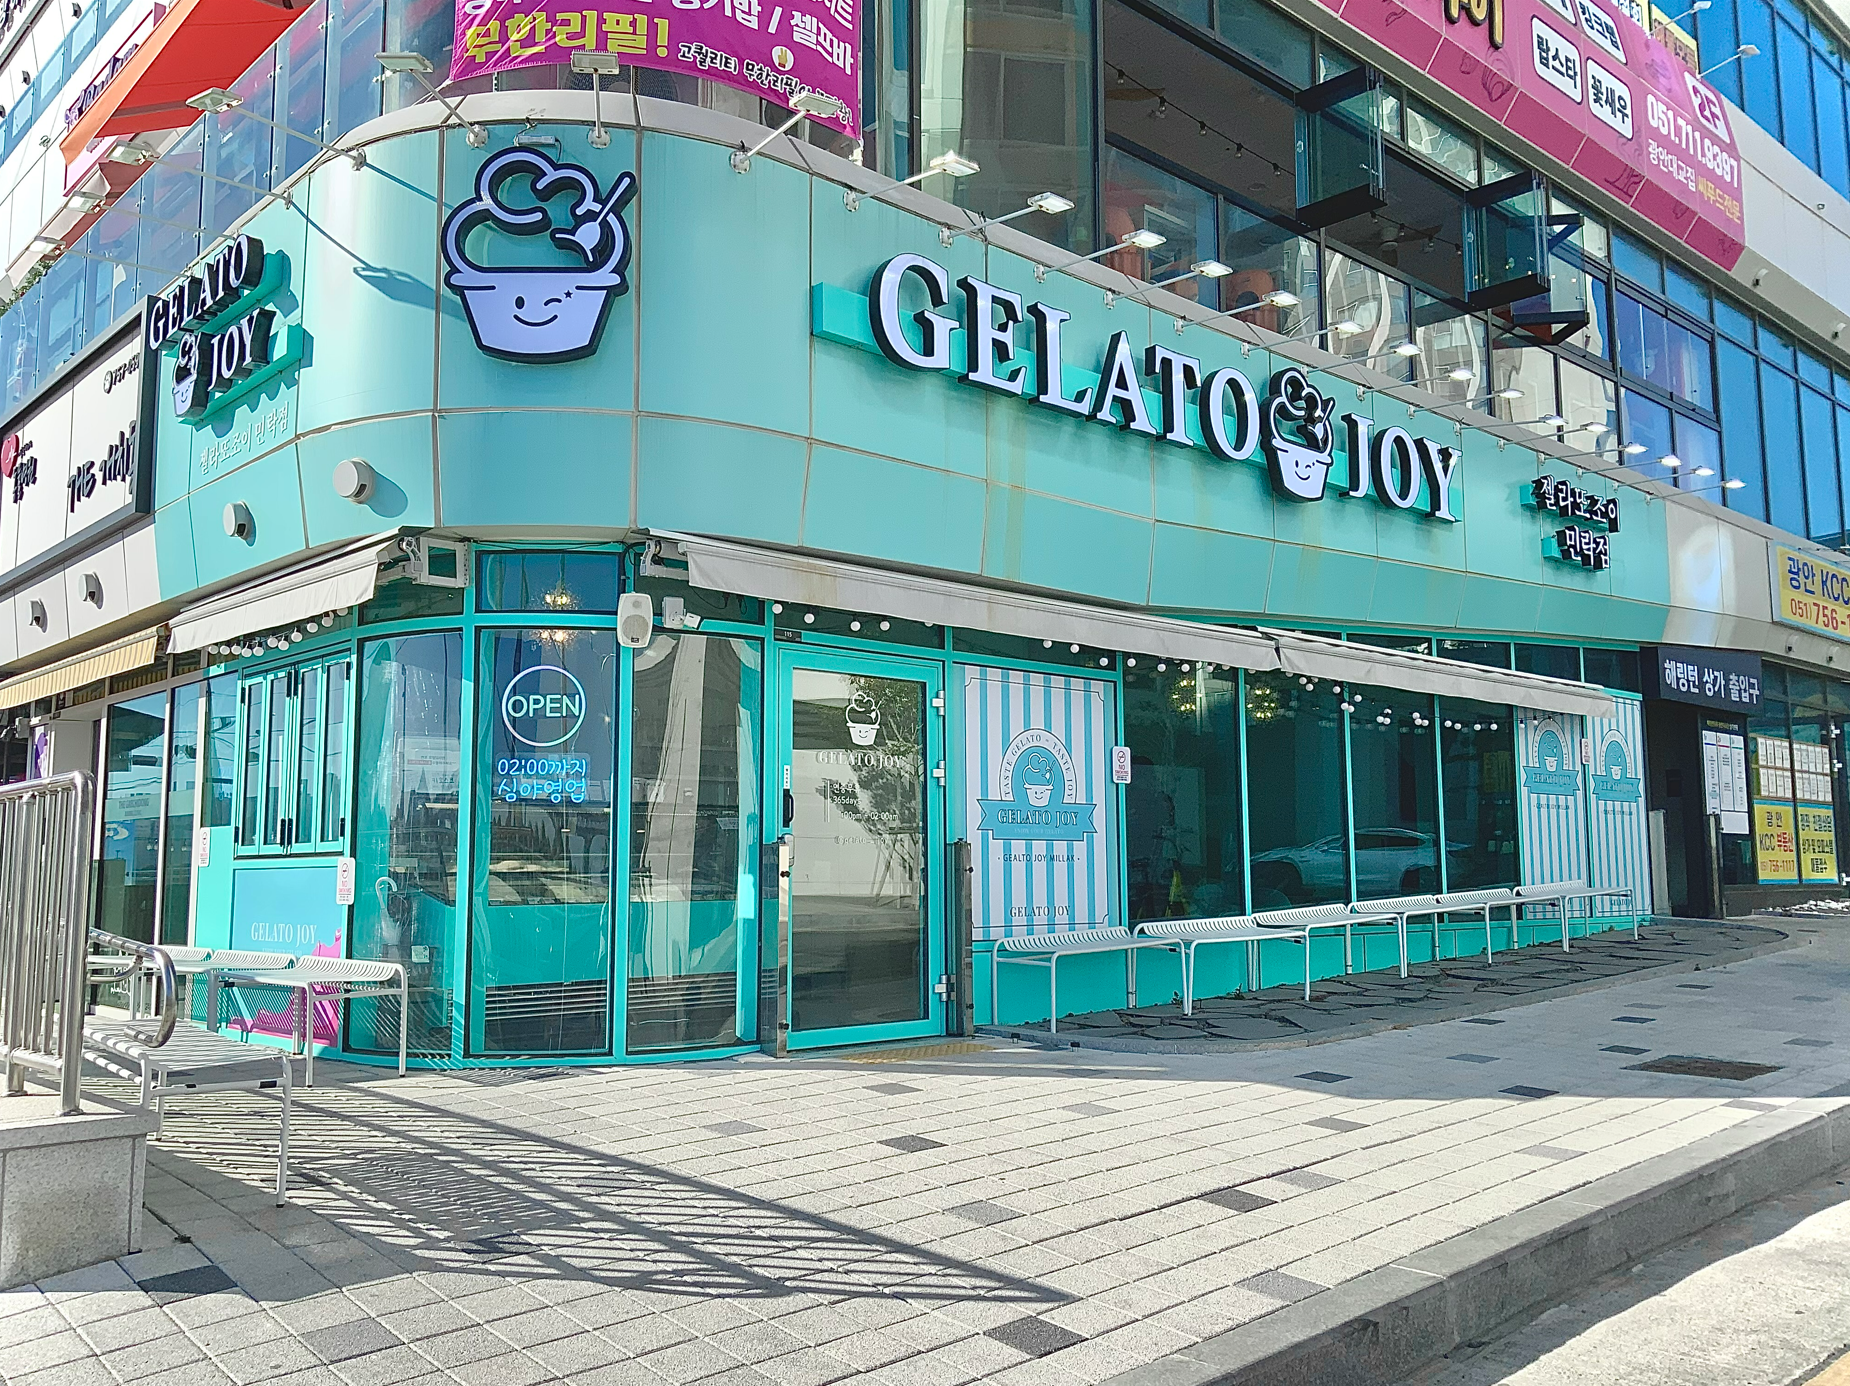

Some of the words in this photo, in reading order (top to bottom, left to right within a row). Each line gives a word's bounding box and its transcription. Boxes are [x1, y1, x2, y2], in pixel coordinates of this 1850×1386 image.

[463, 10, 670, 63] 무한리필!
[1578, 0, 1621, 52] 킹크랩
[678, 42, 740, 76] 고퀄리티
[1536, 32, 1579, 90] 랍스타
[1591, 73, 1631, 126] 꽃새우
[1692, 84, 1722, 131] 2F
[1646, 93, 1739, 189] 051.711.9397
[1648, 138, 1697, 193] 광안대교집
[1698, 175, 1741, 225] 씨푸드전문
[149, 233, 254, 351] GELATO
[208, 306, 262, 392] JOY
[870, 253, 1260, 461] GELATO
[1342, 412, 1463, 523] JOY
[254, 400, 290, 448] 민락점
[1534, 474, 1620, 533] 젤라또조이
[1558, 525, 1610, 570] 민락점
[1787, 555, 1816, 596] 광안
[1820, 568, 1850, 606] KCC
[507, 693, 580, 718] OPEN
[1664, 659, 1700, 694] 해링턴
[1703, 667, 1726, 699] 상가
[1729, 672, 1760, 705] 출입구
[497, 758, 587, 776] 02:00까지
[819, 750, 875, 766] GELATO
[877, 752, 903, 770] JOY
[1004, 759, 1013, 798] TASTE
[1011, 734, 1042, 757] GELATO
[1053, 742, 1072, 775] TASTE
[1066, 778, 1076, 800] JOY
[497, 777, 587, 804] 심야영업
[997, 808, 1051, 825] GELATO
[1055, 810, 1079, 829] JOY
[1760, 833, 1775, 852] KCC
[1777, 831, 1793, 852] 부동산
[1003, 853, 1031, 863] GEALTO
[1033, 854, 1046, 863] JOY
[1049, 854, 1075, 863] MILLAK
[251, 921, 293, 944] GELATO
[296, 924, 317, 948] JOY
[1010, 906, 1050, 917] GELATO
[1053, 905, 1071, 918] JOY
